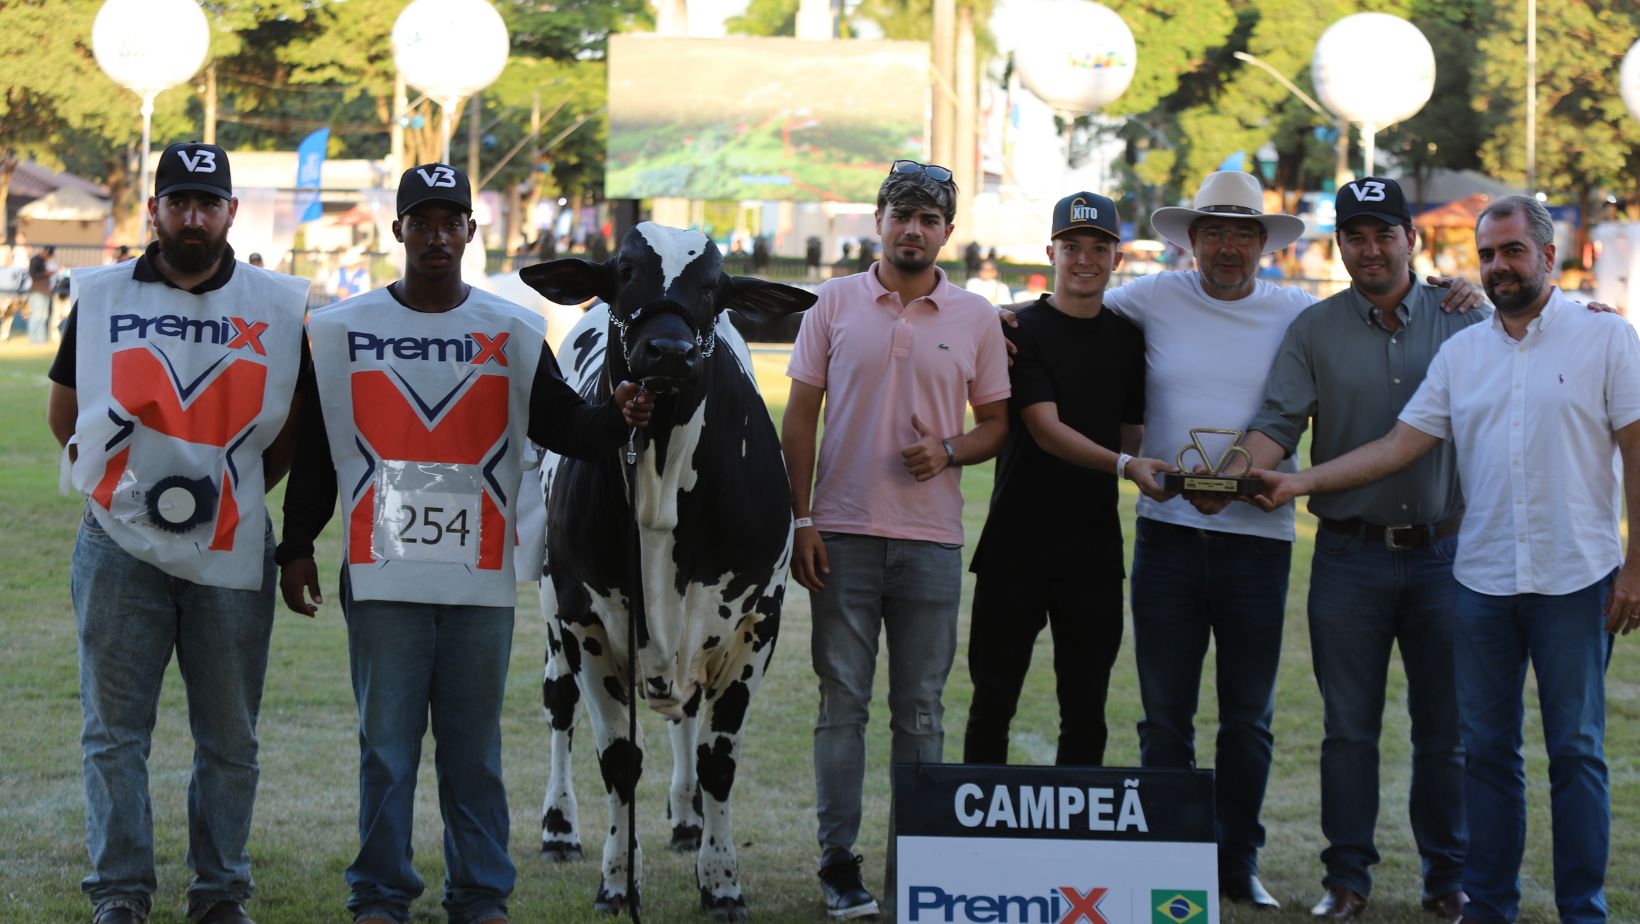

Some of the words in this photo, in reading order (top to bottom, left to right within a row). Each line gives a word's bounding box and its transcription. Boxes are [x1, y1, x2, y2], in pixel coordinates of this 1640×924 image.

[177, 149, 216, 173] V3
[416, 166, 456, 188] V3
[1349, 181, 1386, 202] V3
[397, 504, 470, 546] 254
[954, 778, 1149, 833] CAMPEÃ
